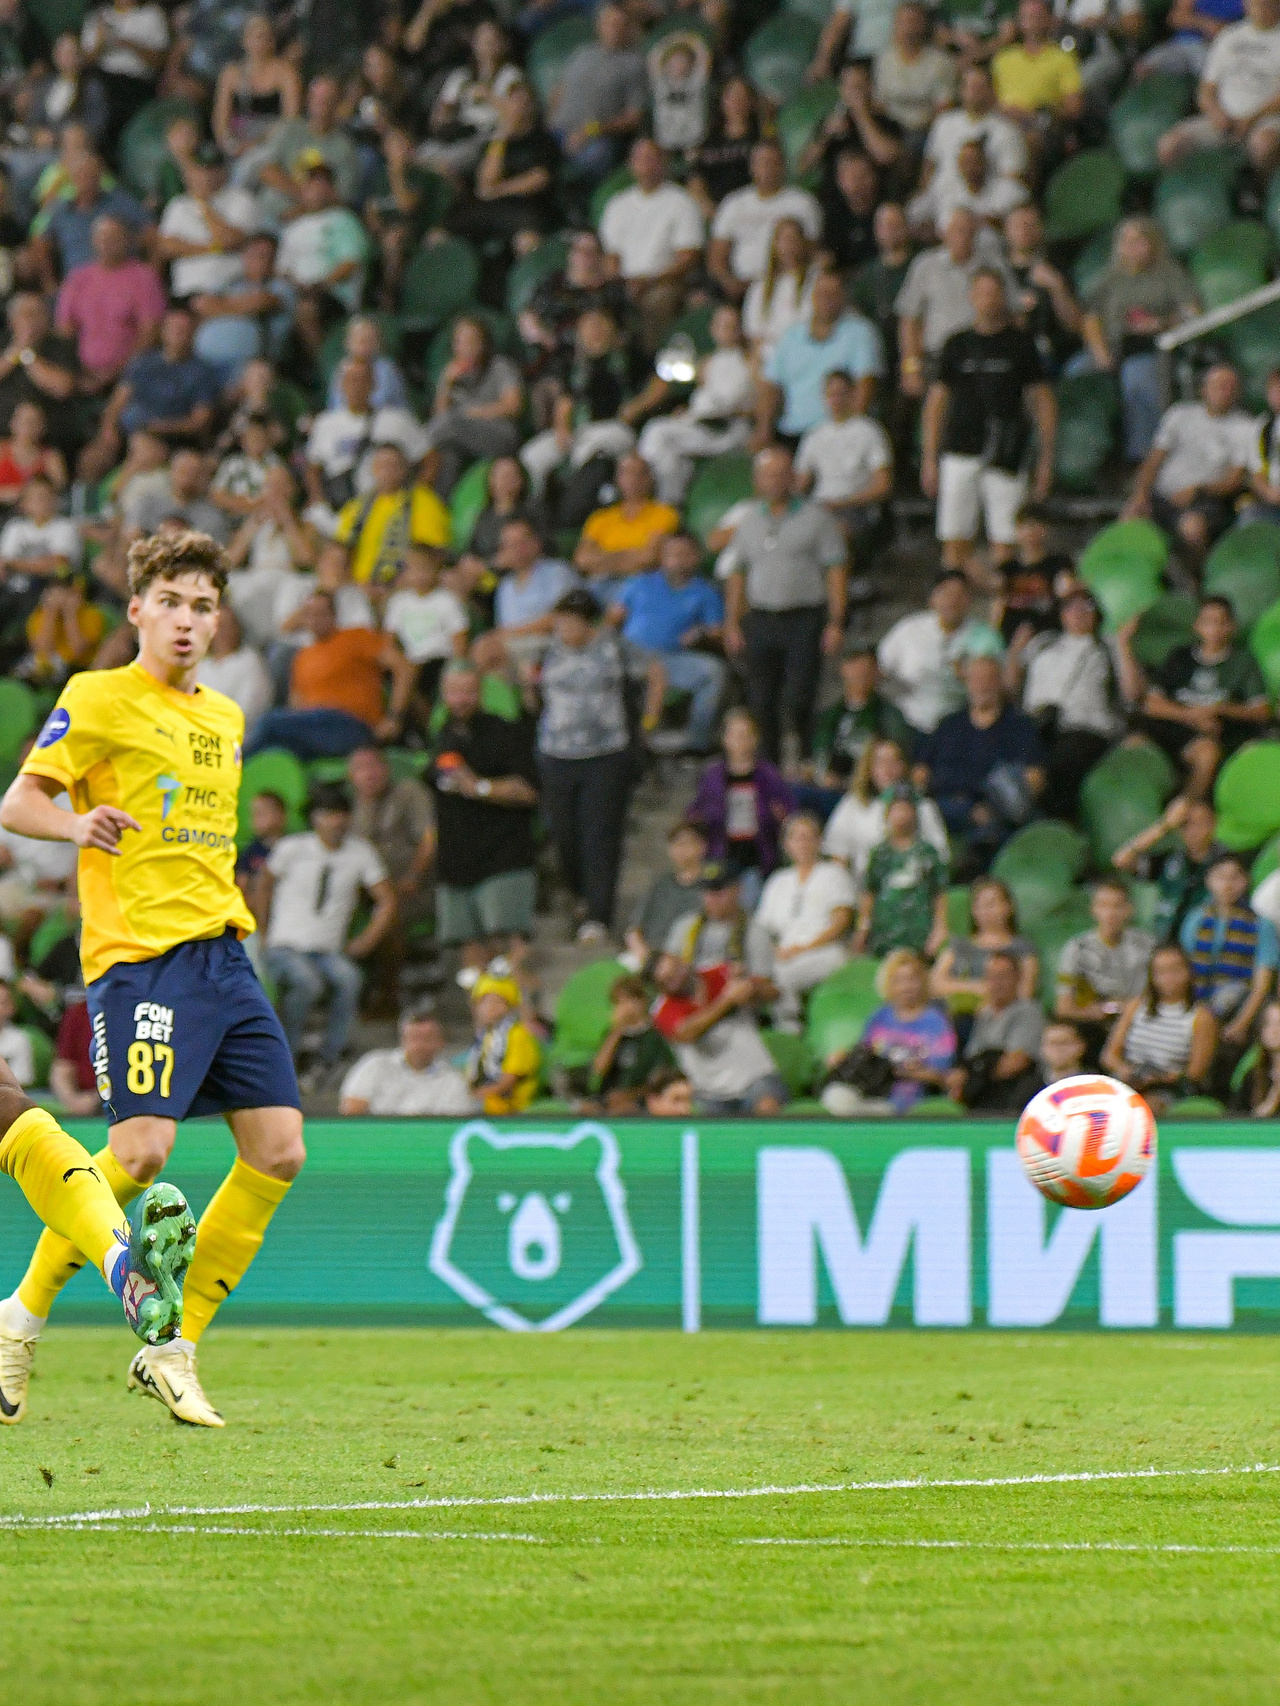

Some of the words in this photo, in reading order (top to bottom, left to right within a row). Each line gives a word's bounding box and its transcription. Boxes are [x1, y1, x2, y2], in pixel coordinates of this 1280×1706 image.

[189, 732, 220, 749] FON
[193, 750, 222, 769] BET
[134, 1002, 174, 1027] FON
[135, 1020, 174, 1043] BET
[127, 1040, 175, 1098] 87
